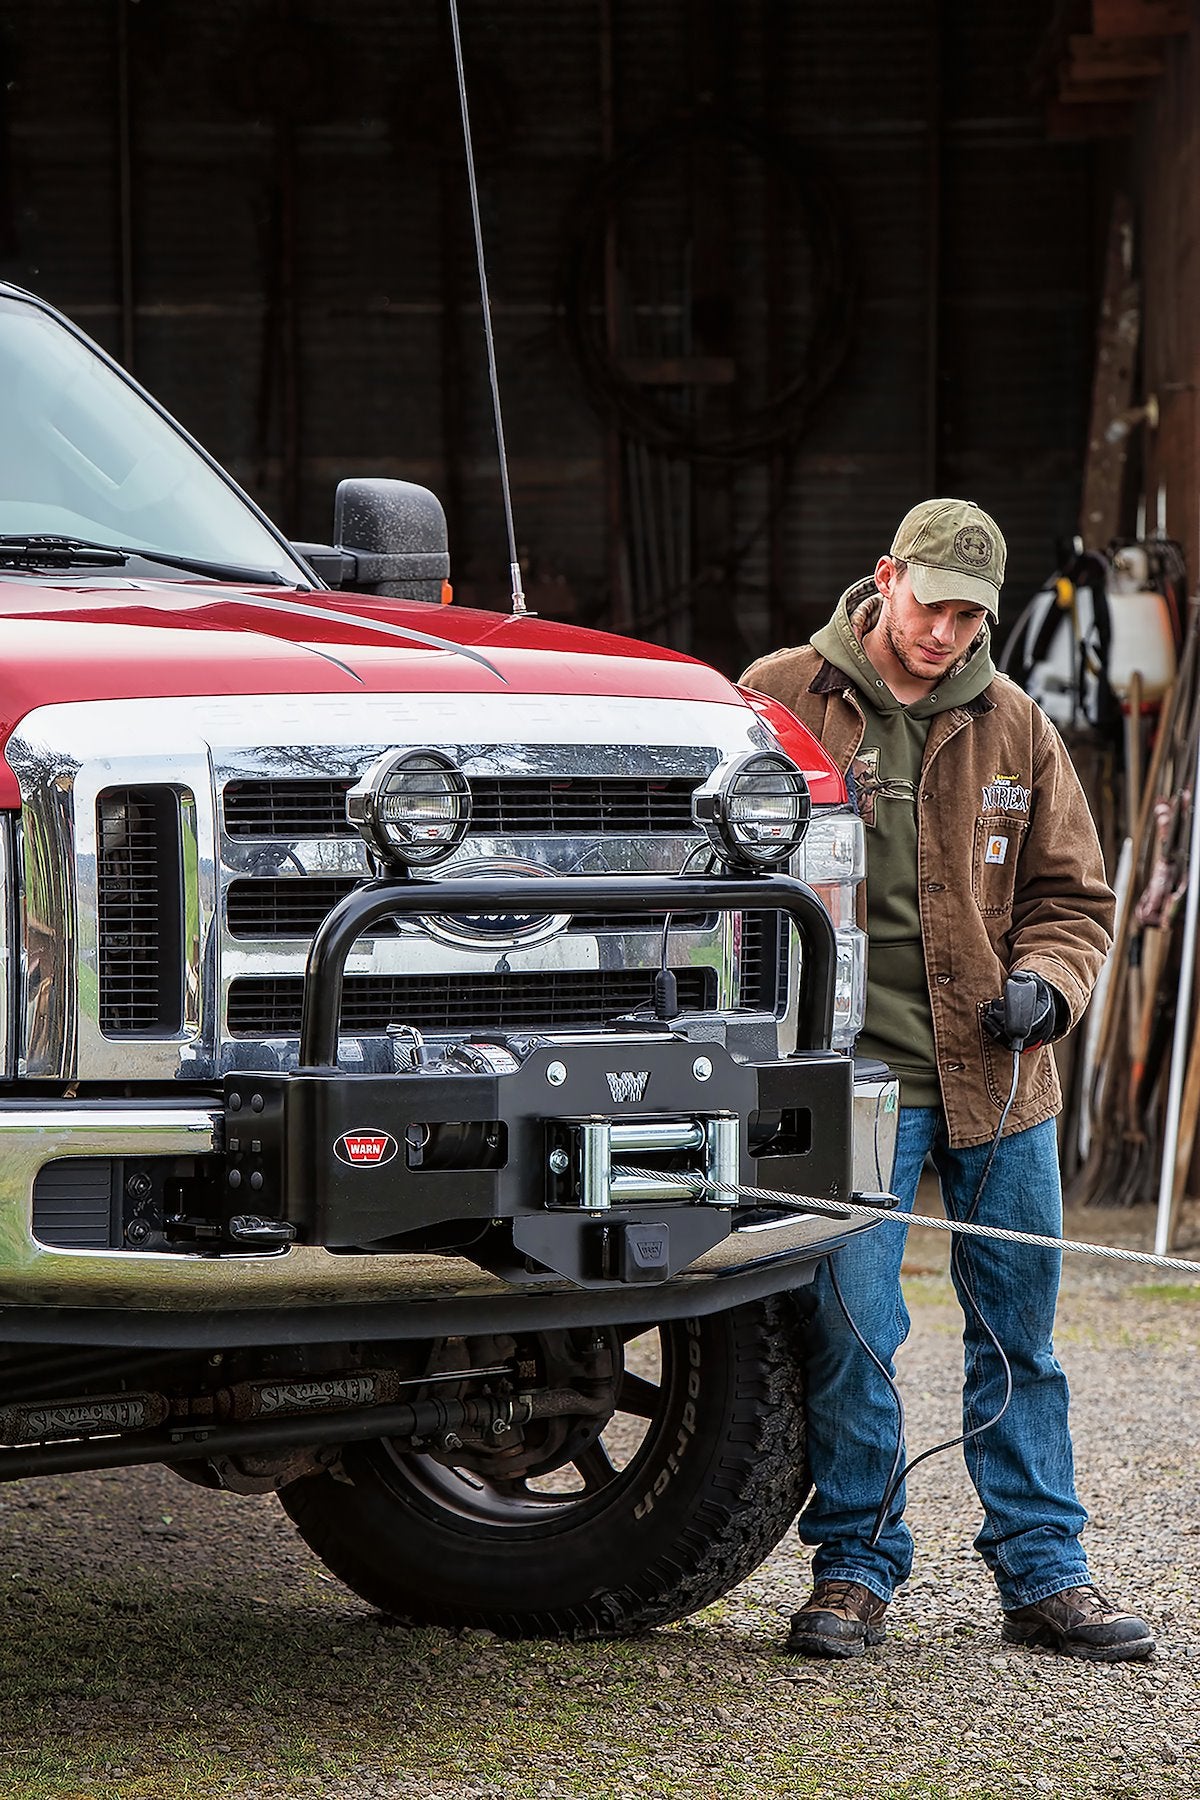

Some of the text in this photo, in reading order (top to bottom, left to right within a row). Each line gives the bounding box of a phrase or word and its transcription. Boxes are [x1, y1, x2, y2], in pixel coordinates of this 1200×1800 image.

[350, 1144, 380, 1155] WARN
[260, 1378, 375, 1413] SKYJACKER
[27, 1401, 146, 1437] SKYJACKER
